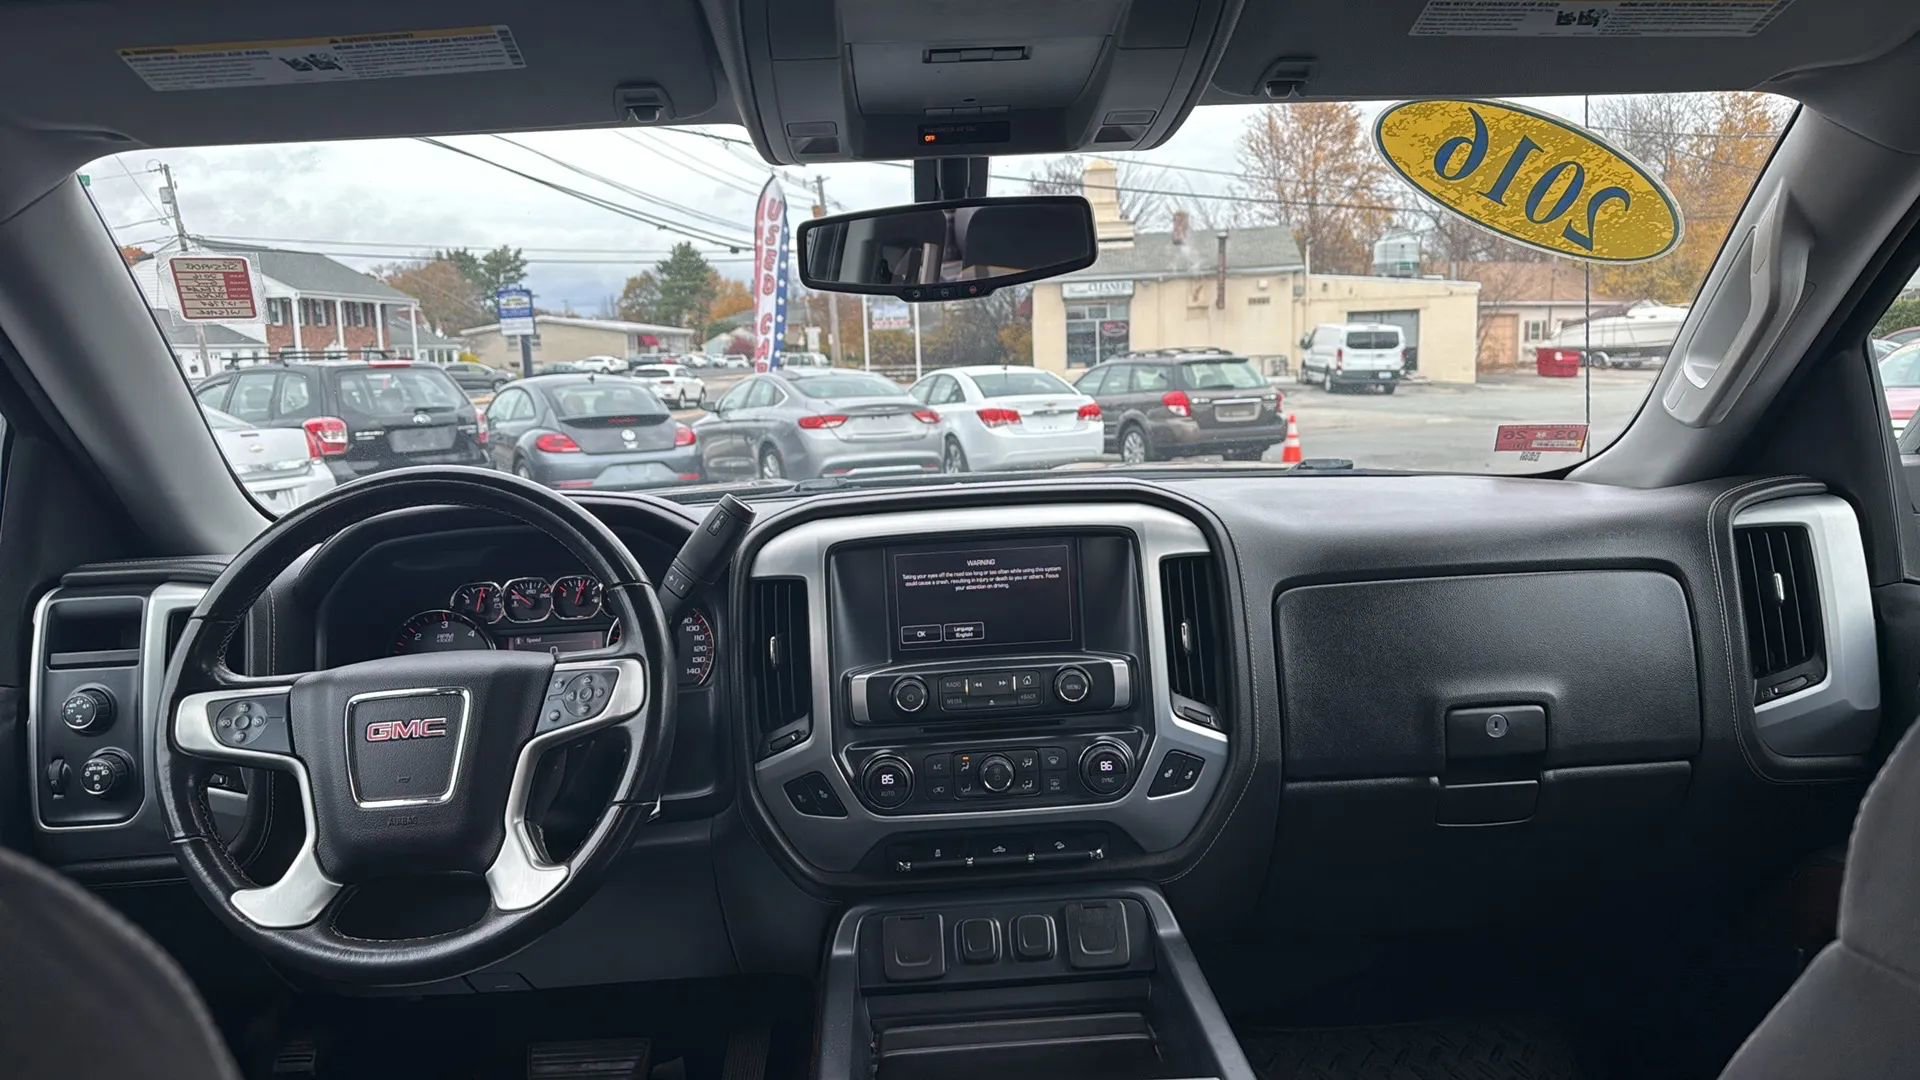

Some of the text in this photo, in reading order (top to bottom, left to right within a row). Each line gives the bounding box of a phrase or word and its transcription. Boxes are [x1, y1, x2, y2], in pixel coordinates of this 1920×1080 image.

[762, 198, 783, 296] USED
[441, 621, 448, 629] 3
[415, 633, 422, 641] 2
[468, 630, 475, 638] 4
[366, 718, 447, 742] GMC
[1100, 760, 1113, 771] 86
[882, 774, 894, 784] 85
